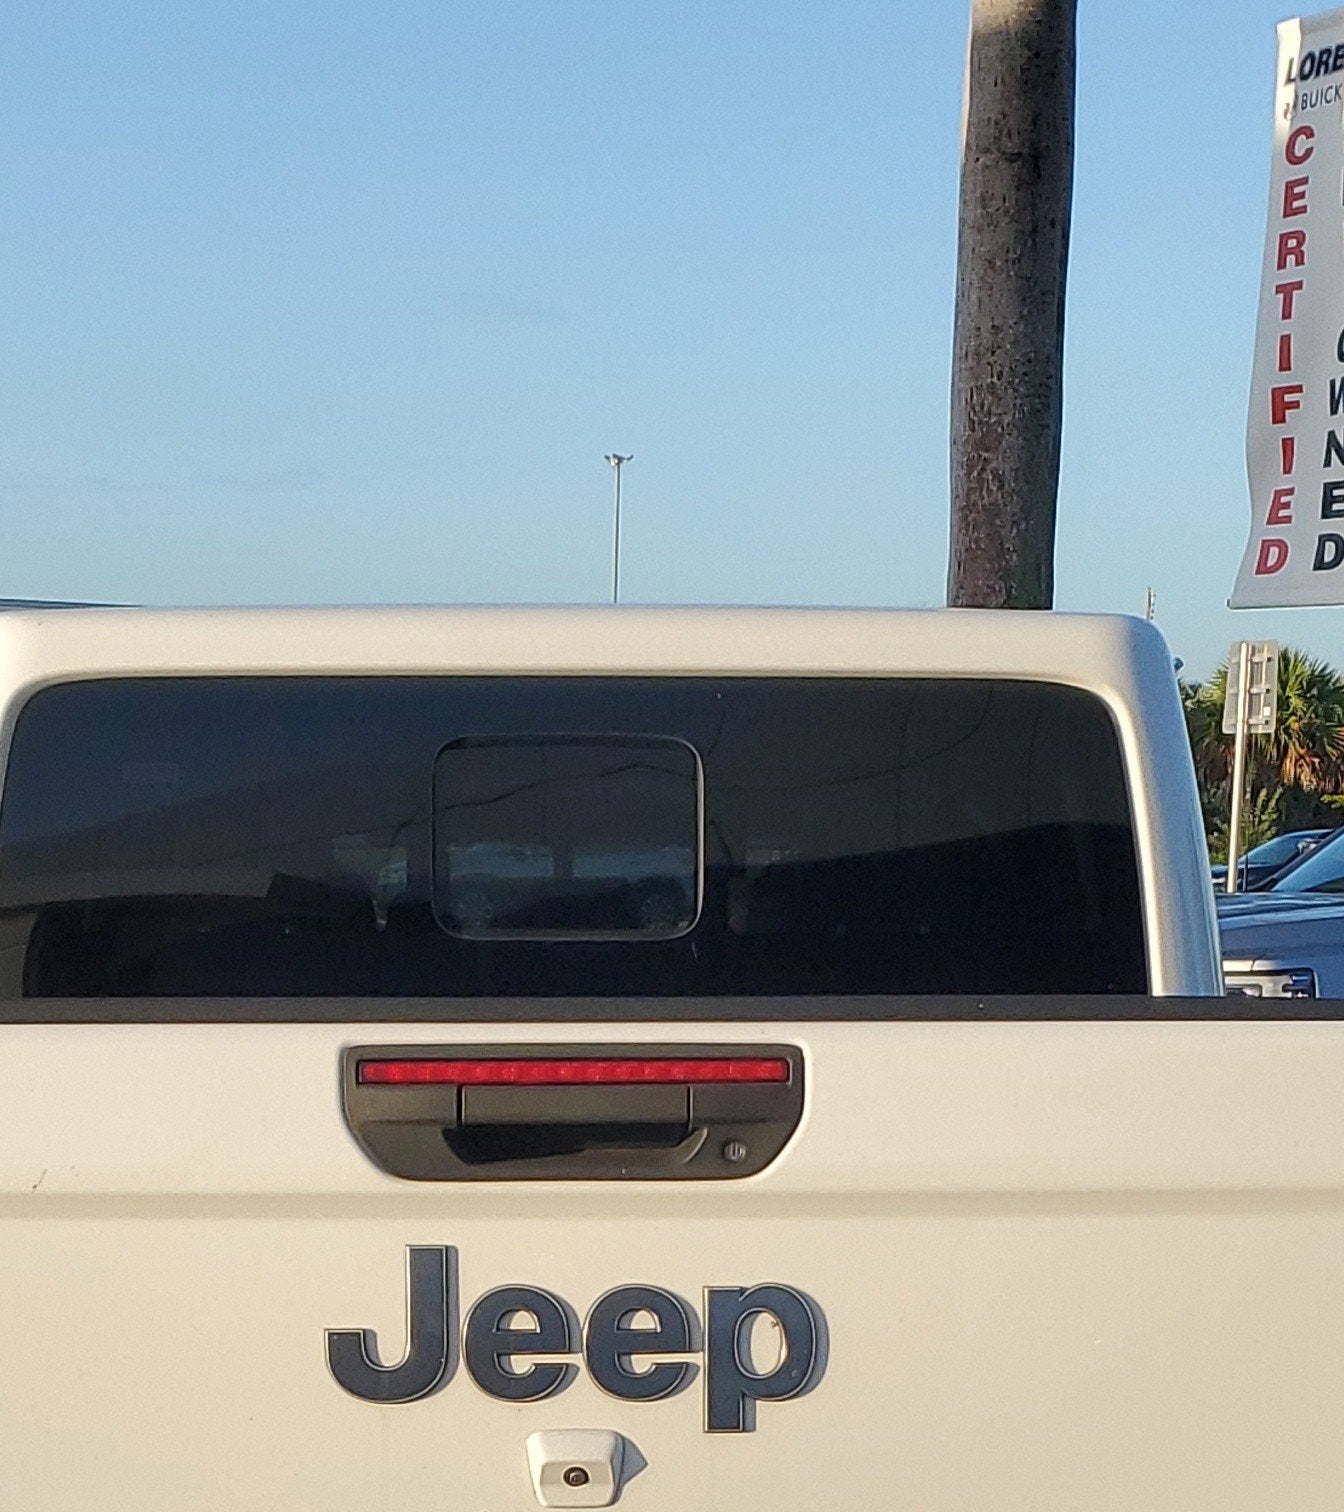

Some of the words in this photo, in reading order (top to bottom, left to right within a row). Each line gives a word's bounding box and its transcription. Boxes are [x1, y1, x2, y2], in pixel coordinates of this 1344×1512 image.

[1300, 82, 1343, 111] BUICK
[1254, 125, 1316, 576] CERTIFIED
[323, 1244, 821, 1433] Jeep
